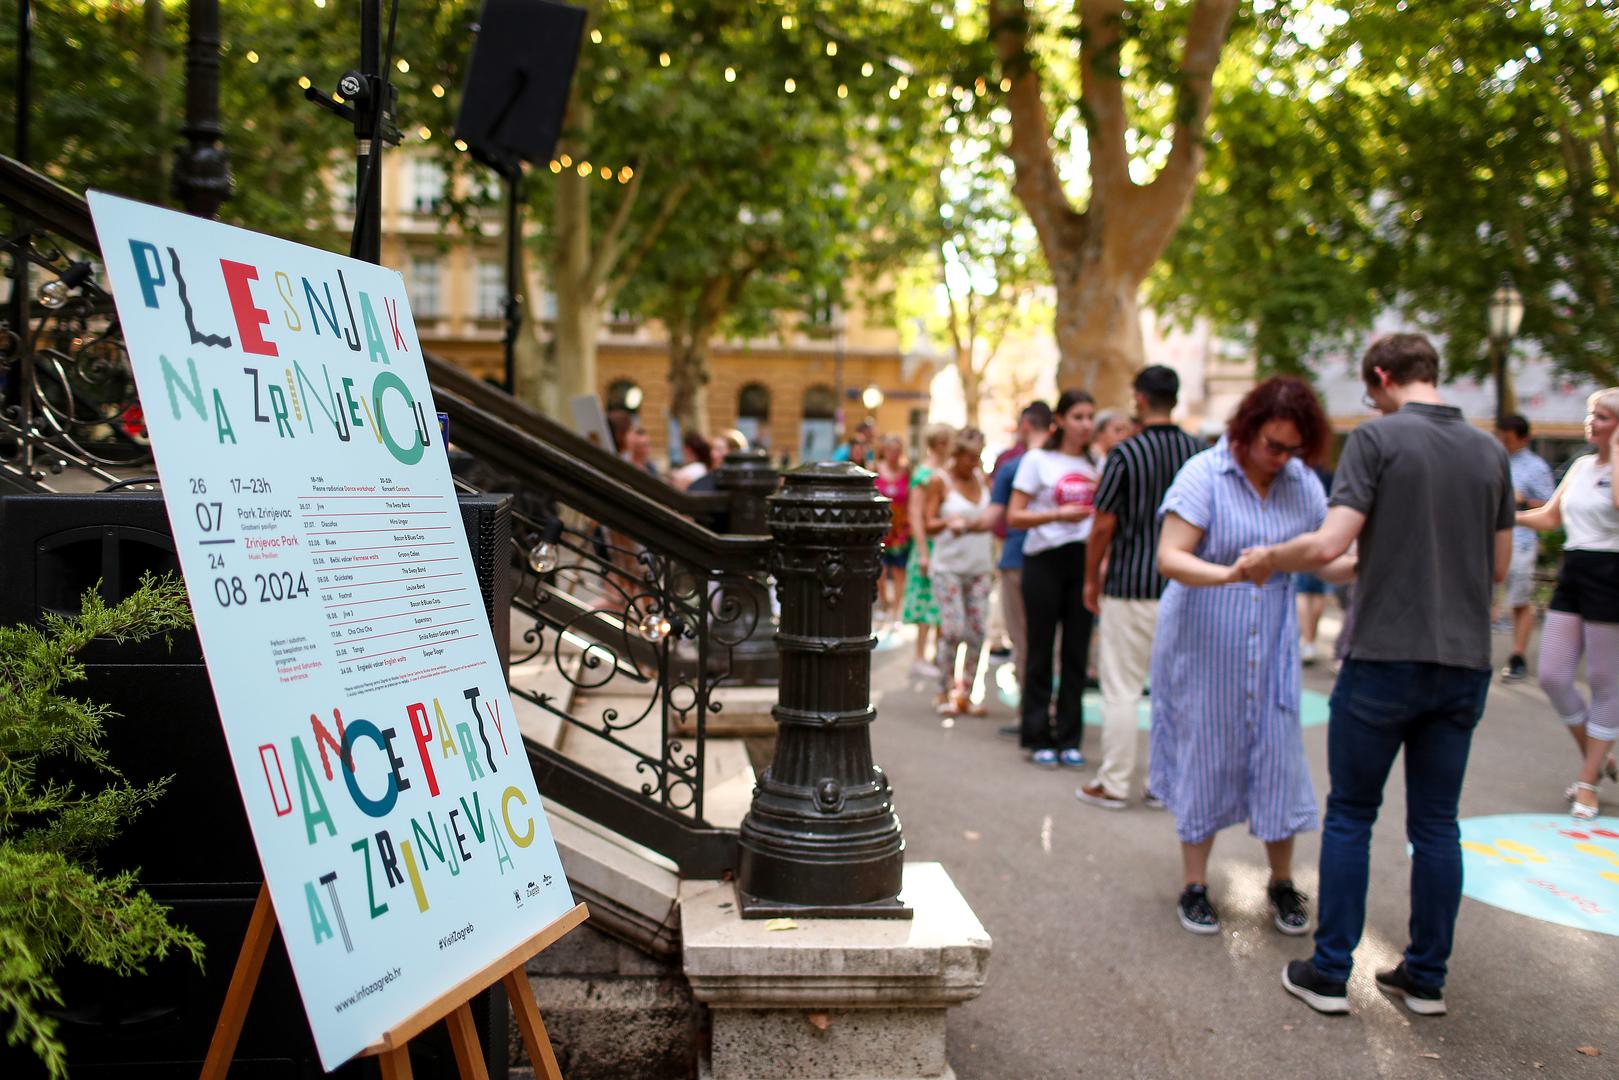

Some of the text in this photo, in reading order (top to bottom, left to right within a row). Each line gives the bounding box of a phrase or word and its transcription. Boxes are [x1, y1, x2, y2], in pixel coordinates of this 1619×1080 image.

[128, 238, 408, 364] PLESNJAK
[159, 354, 431, 465] NA ZRINJEVCU
[190, 478, 206, 494] 26
[196, 502, 222, 532] 07
[238, 507, 292, 520] Park Zrinjevac
[245, 536, 298, 550] Zrinjevac Park
[208, 554, 224, 569] 24
[215, 571, 309, 607] 08 2024
[258, 687, 508, 845] DANCE PARTY
[304, 786, 535, 953] AT ZRINJEVAC
[439, 922, 474, 950] #VisitZagreb
[334, 967, 401, 1013] www.infozagreb.hr
